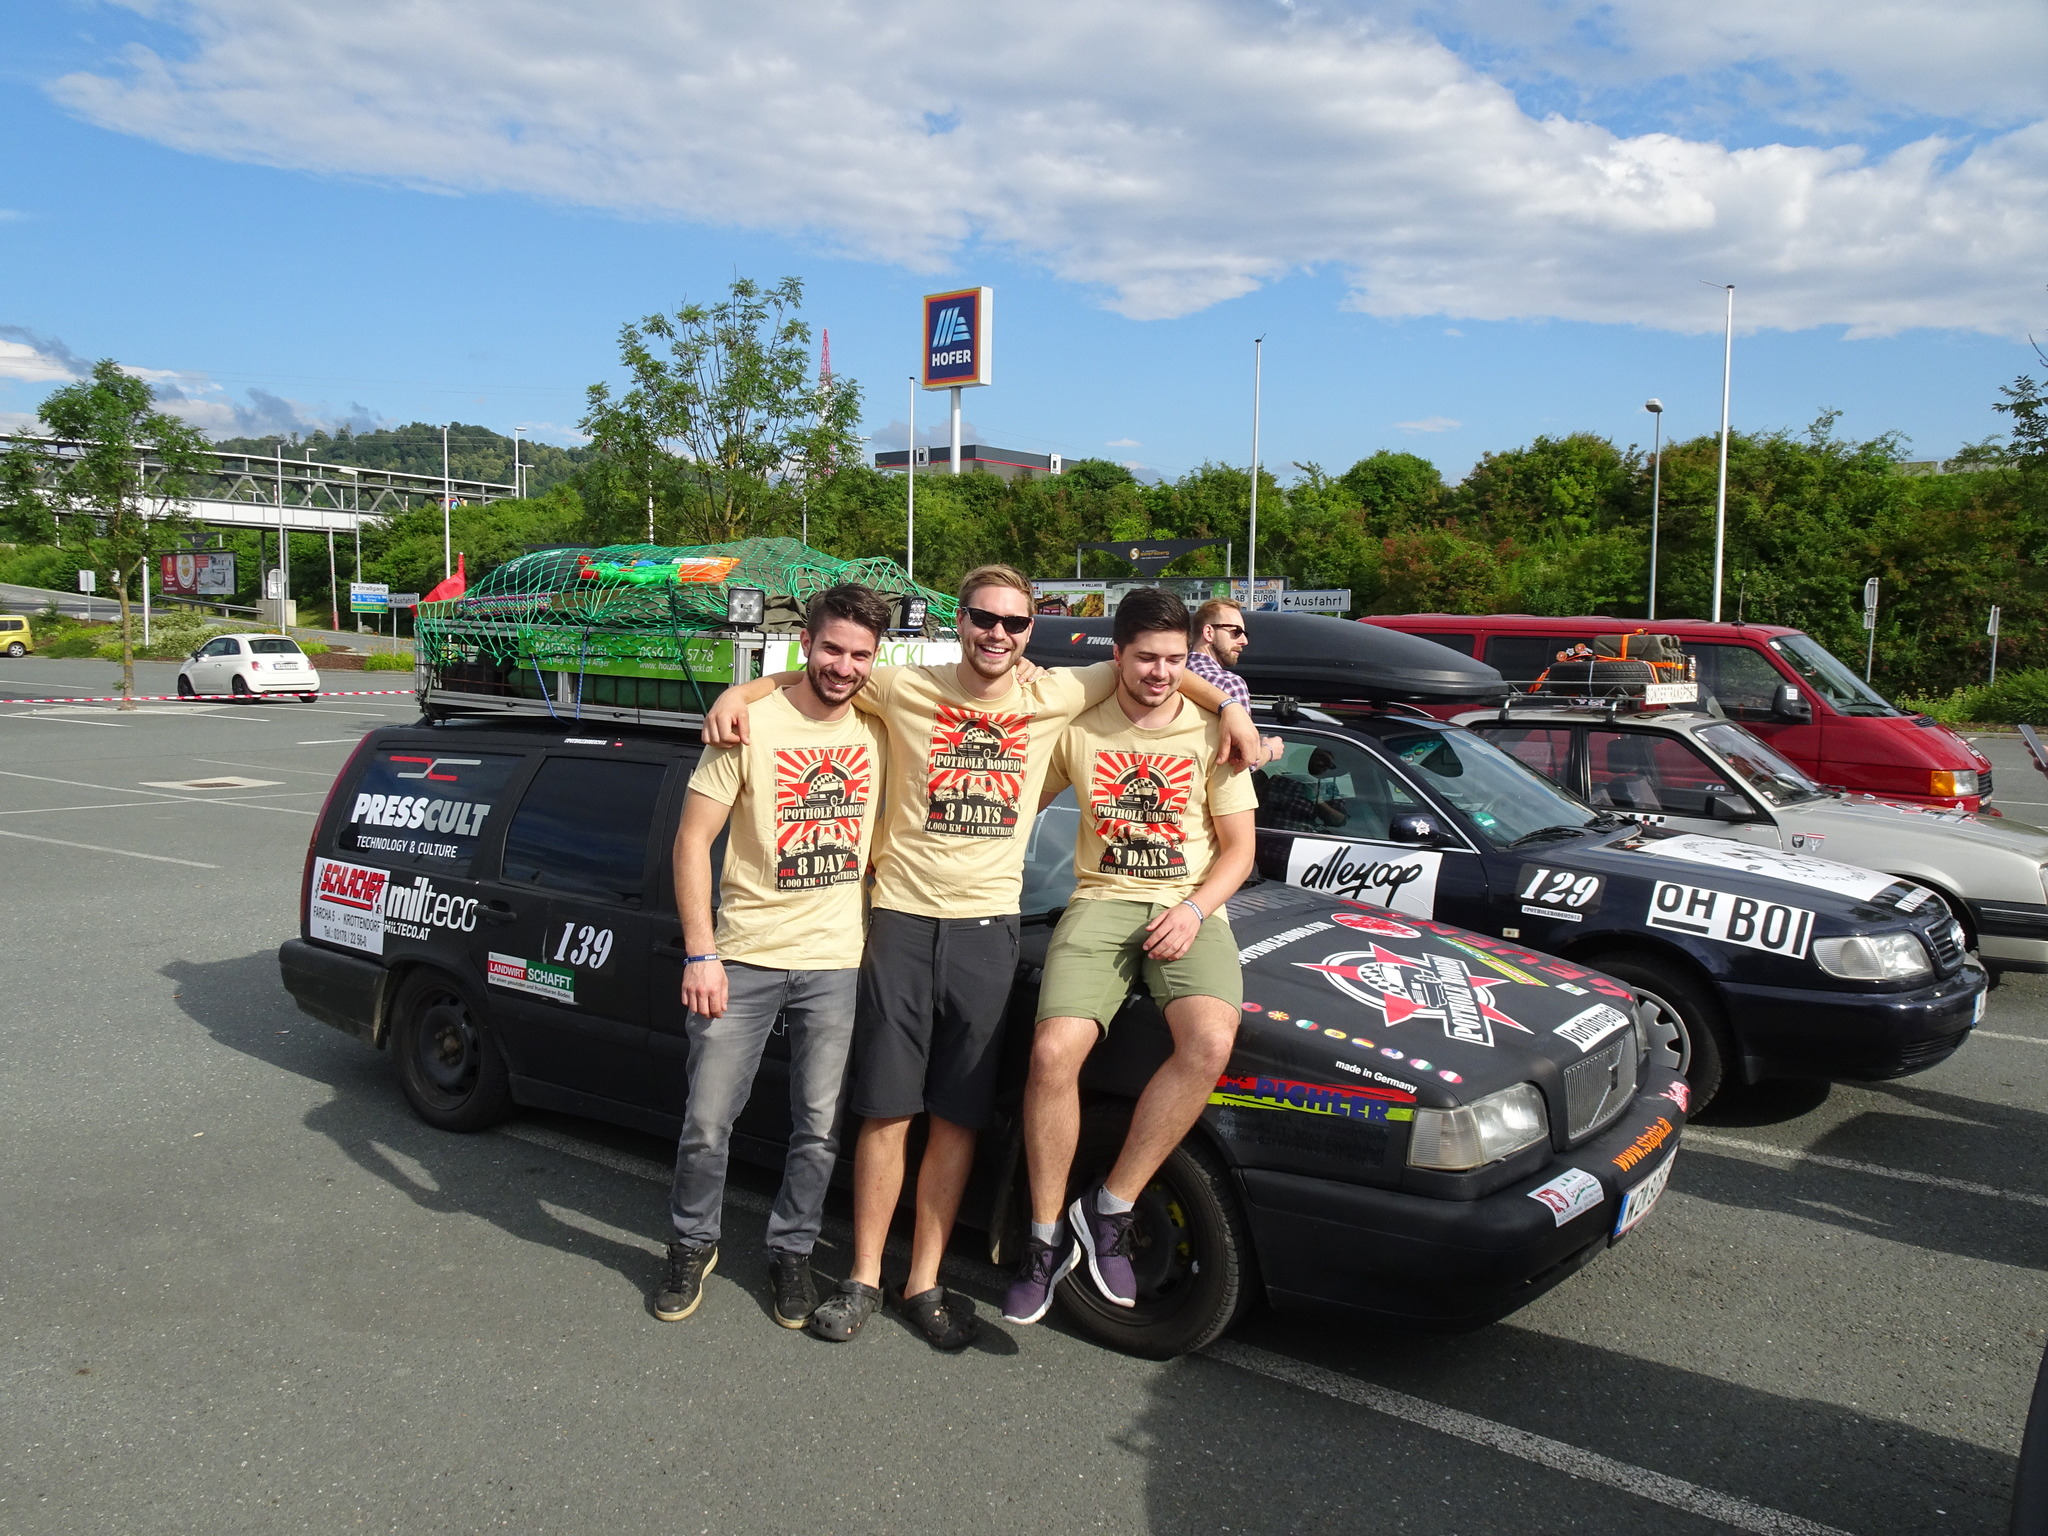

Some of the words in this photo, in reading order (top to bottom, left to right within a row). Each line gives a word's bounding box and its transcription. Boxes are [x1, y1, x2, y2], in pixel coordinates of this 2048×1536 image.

[932, 349, 972, 367] HOFER
[1253, 594, 1276, 602] EURO!
[1294, 596, 1342, 607] Ausfahrt
[1086, 636, 1115, 646] THUL
[592, 659, 610, 668] Anger
[702, 649, 715, 662] 78
[936, 754, 984, 769] POTHOLE
[986, 758, 1020, 772] RODEO
[350, 793, 491, 837] PRESSCULT
[784, 807, 832, 820] POTHOLE
[833, 803, 864, 818] RODEO
[945, 802, 956, 821] 8
[960, 804, 1002, 824] DAYS
[1097, 805, 1144, 822] POTHOLE
[1145, 811, 1178, 824] RODEO
[926, 821, 947, 831] 4.000
[948, 823, 962, 832] KM
[966, 825, 975, 834] 11
[976, 826, 1015, 836] COUNTRIES
[356, 836, 408, 852] TECHNOLOGY
[409, 840, 416, 853] &
[418, 842, 458, 858] CULTURE
[1112, 847, 1122, 865] 8
[1127, 848, 1168, 867] DAYS
[779, 868, 796, 877] JULI
[797, 857, 808, 876] 8
[814, 853, 849, 874] DAY
[1143, 865, 1187, 878] COUNTRIES
[321, 863, 386, 903] SCHLACHER
[779, 878, 802, 888] 4.000
[803, 877, 816, 887] KM
[819, 876, 828, 885] 11
[1300, 845, 1423, 908] alleyoop
[1520, 868, 1600, 907] 129
[386, 876, 479, 932] milteco
[343, 912, 381, 932] KROTTENDORF
[1656, 884, 1718, 920] OH
[1726, 897, 1810, 956] BOI
[553, 922, 613, 969] 139
[490, 962, 525, 978] LANDWIRT
[527, 967, 572, 990] SCHAFFT
[1432, 956, 1468, 987] RODEO
[507, 979, 526, 988] gesunden
[534, 984, 557, 996] fruchtbaren
[1444, 984, 1483, 1041] POTHOLE
[1335, 1060, 1361, 1074] made
[1362, 1067, 1373, 1078] in
[1374, 1071, 1418, 1094] Germany
[1255, 1078, 1391, 1124] PICHLER
